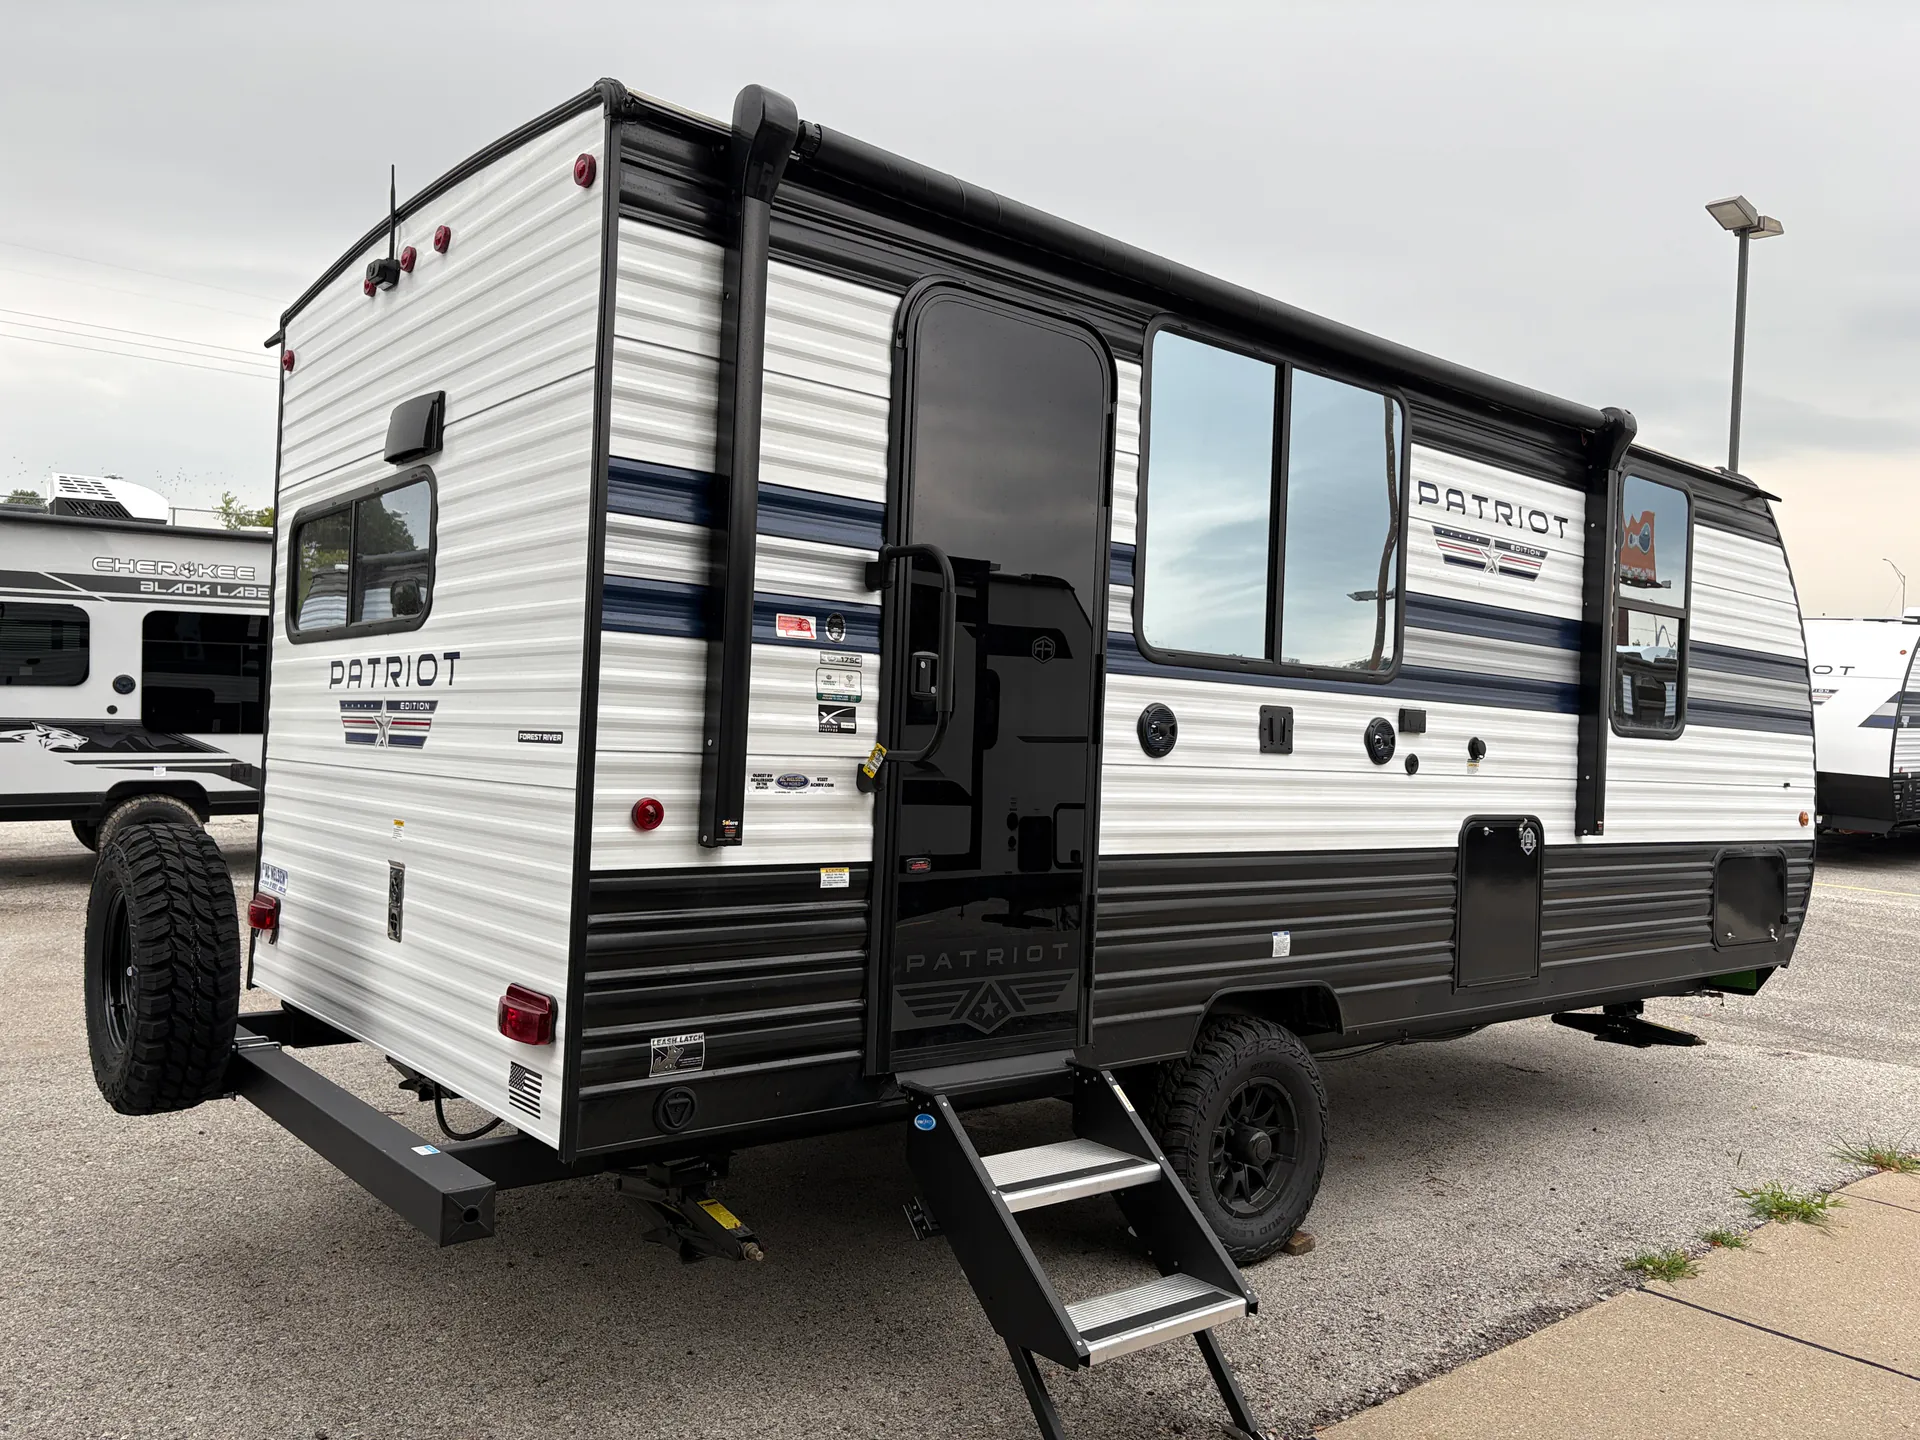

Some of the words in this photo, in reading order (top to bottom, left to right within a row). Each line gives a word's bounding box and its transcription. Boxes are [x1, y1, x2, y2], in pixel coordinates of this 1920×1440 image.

[1418, 480, 1569, 539] PATRIOT
[1510, 544, 1541, 557] EDITION
[140, 581, 211, 595] BLACK
[217, 585, 270, 599] LABE
[329, 651, 461, 690] PATRIOT
[400, 702, 430, 710] EDITION
[519, 732, 542, 741] FOREST
[542, 733, 562, 742] RIVER
[906, 942, 1069, 973] PATRIOT
[652, 1037, 677, 1046] LEASH
[679, 1034, 704, 1043] LATCH
